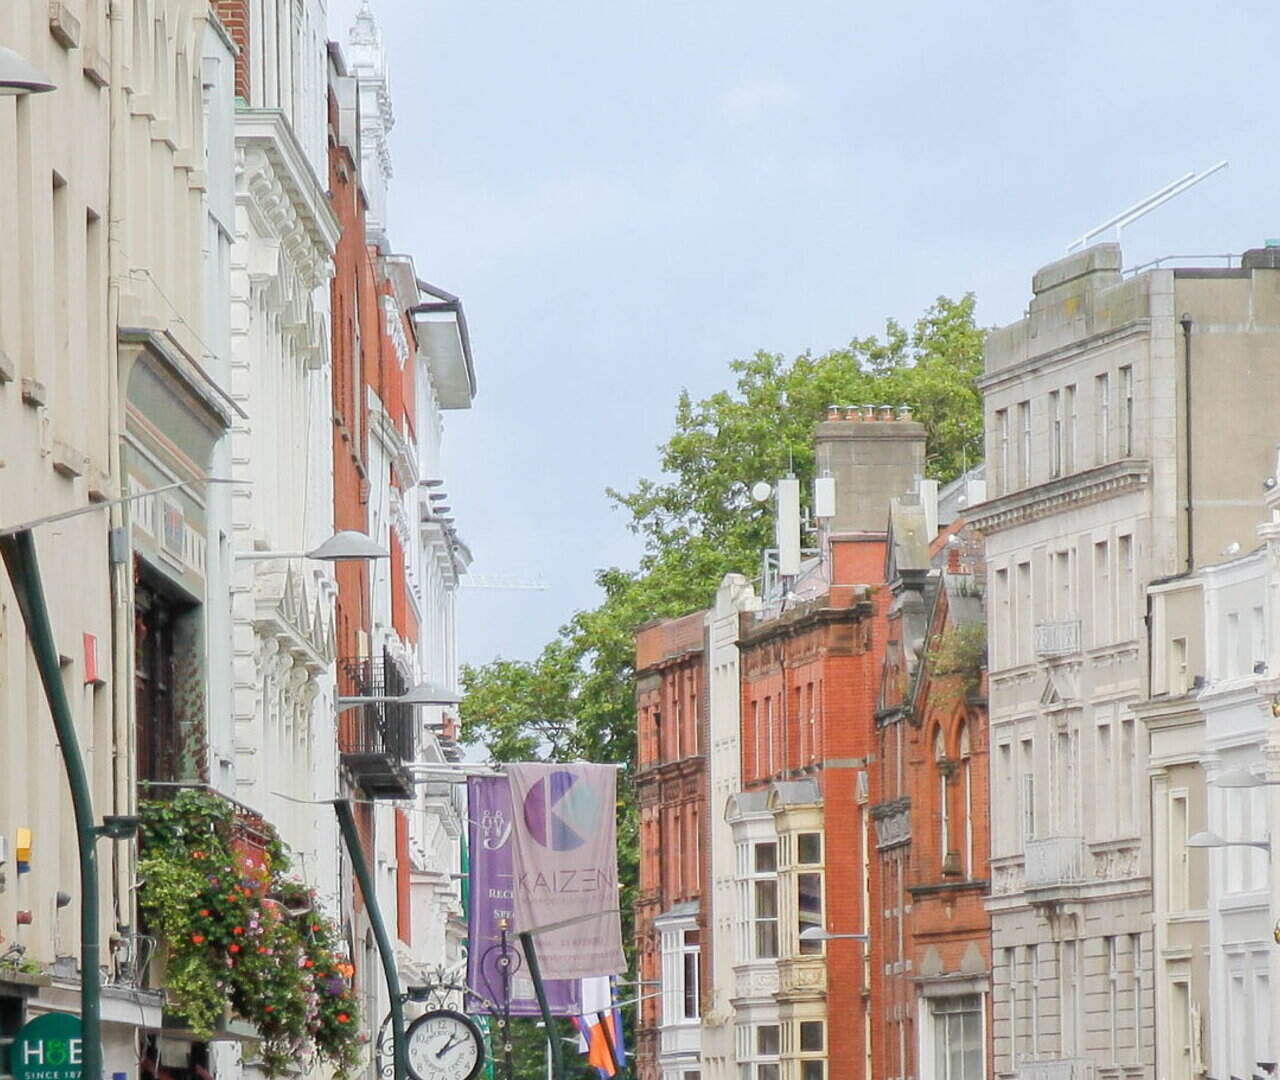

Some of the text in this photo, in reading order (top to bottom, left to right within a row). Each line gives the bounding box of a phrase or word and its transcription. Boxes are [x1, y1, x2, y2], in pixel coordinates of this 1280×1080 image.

[519, 868, 613, 893] KAIZEN
[25, 1071, 82, 1080] SINCE 187
